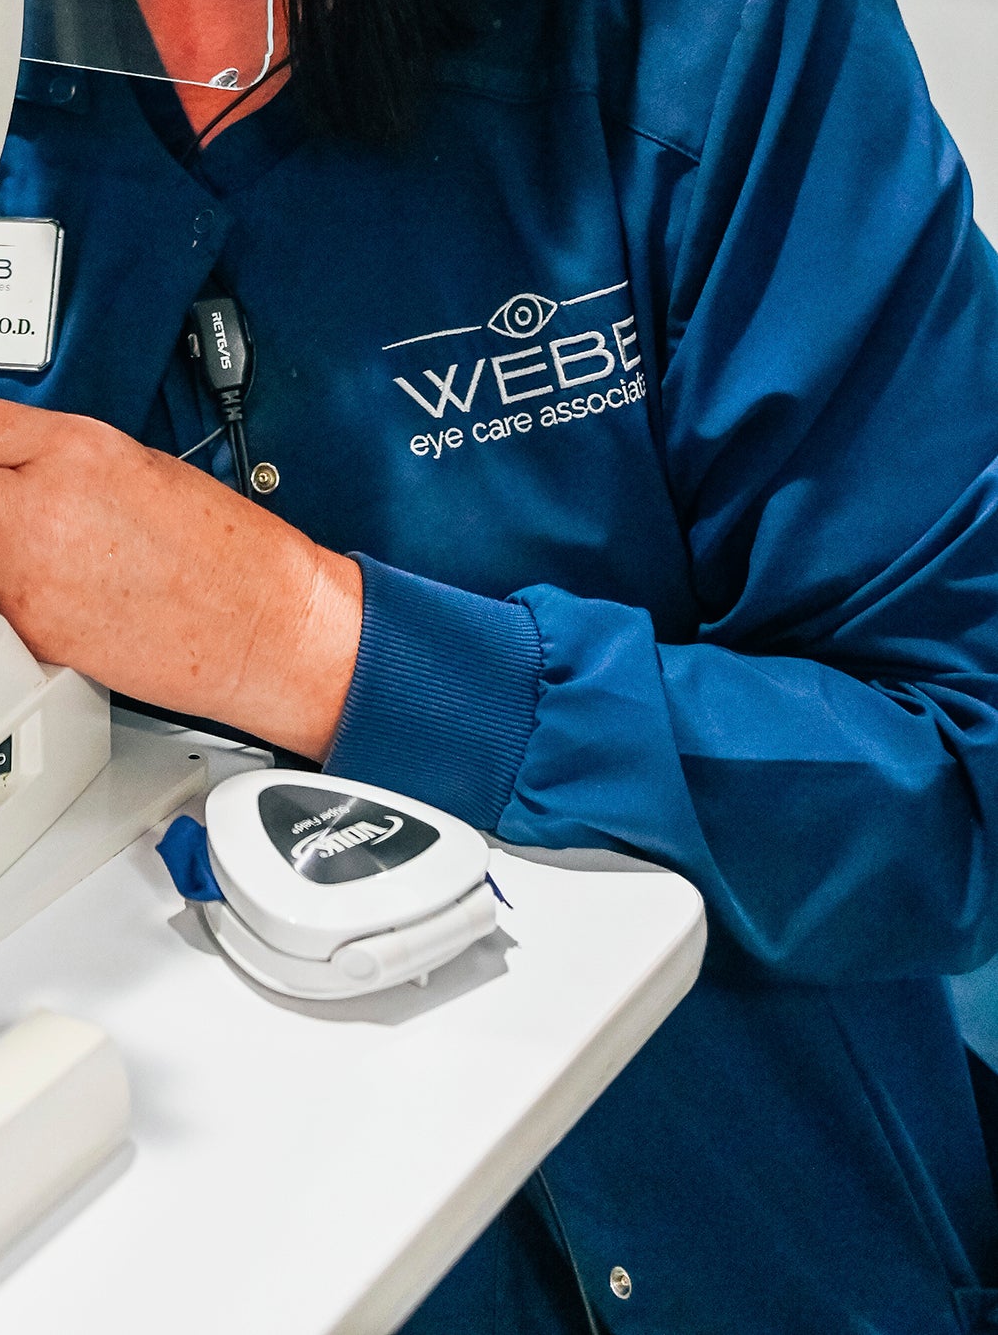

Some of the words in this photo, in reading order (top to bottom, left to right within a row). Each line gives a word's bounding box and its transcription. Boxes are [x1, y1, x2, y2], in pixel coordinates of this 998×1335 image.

[410, 427, 464, 459] eye
[472, 412, 533, 443] care
[540, 371, 647, 428] associat
